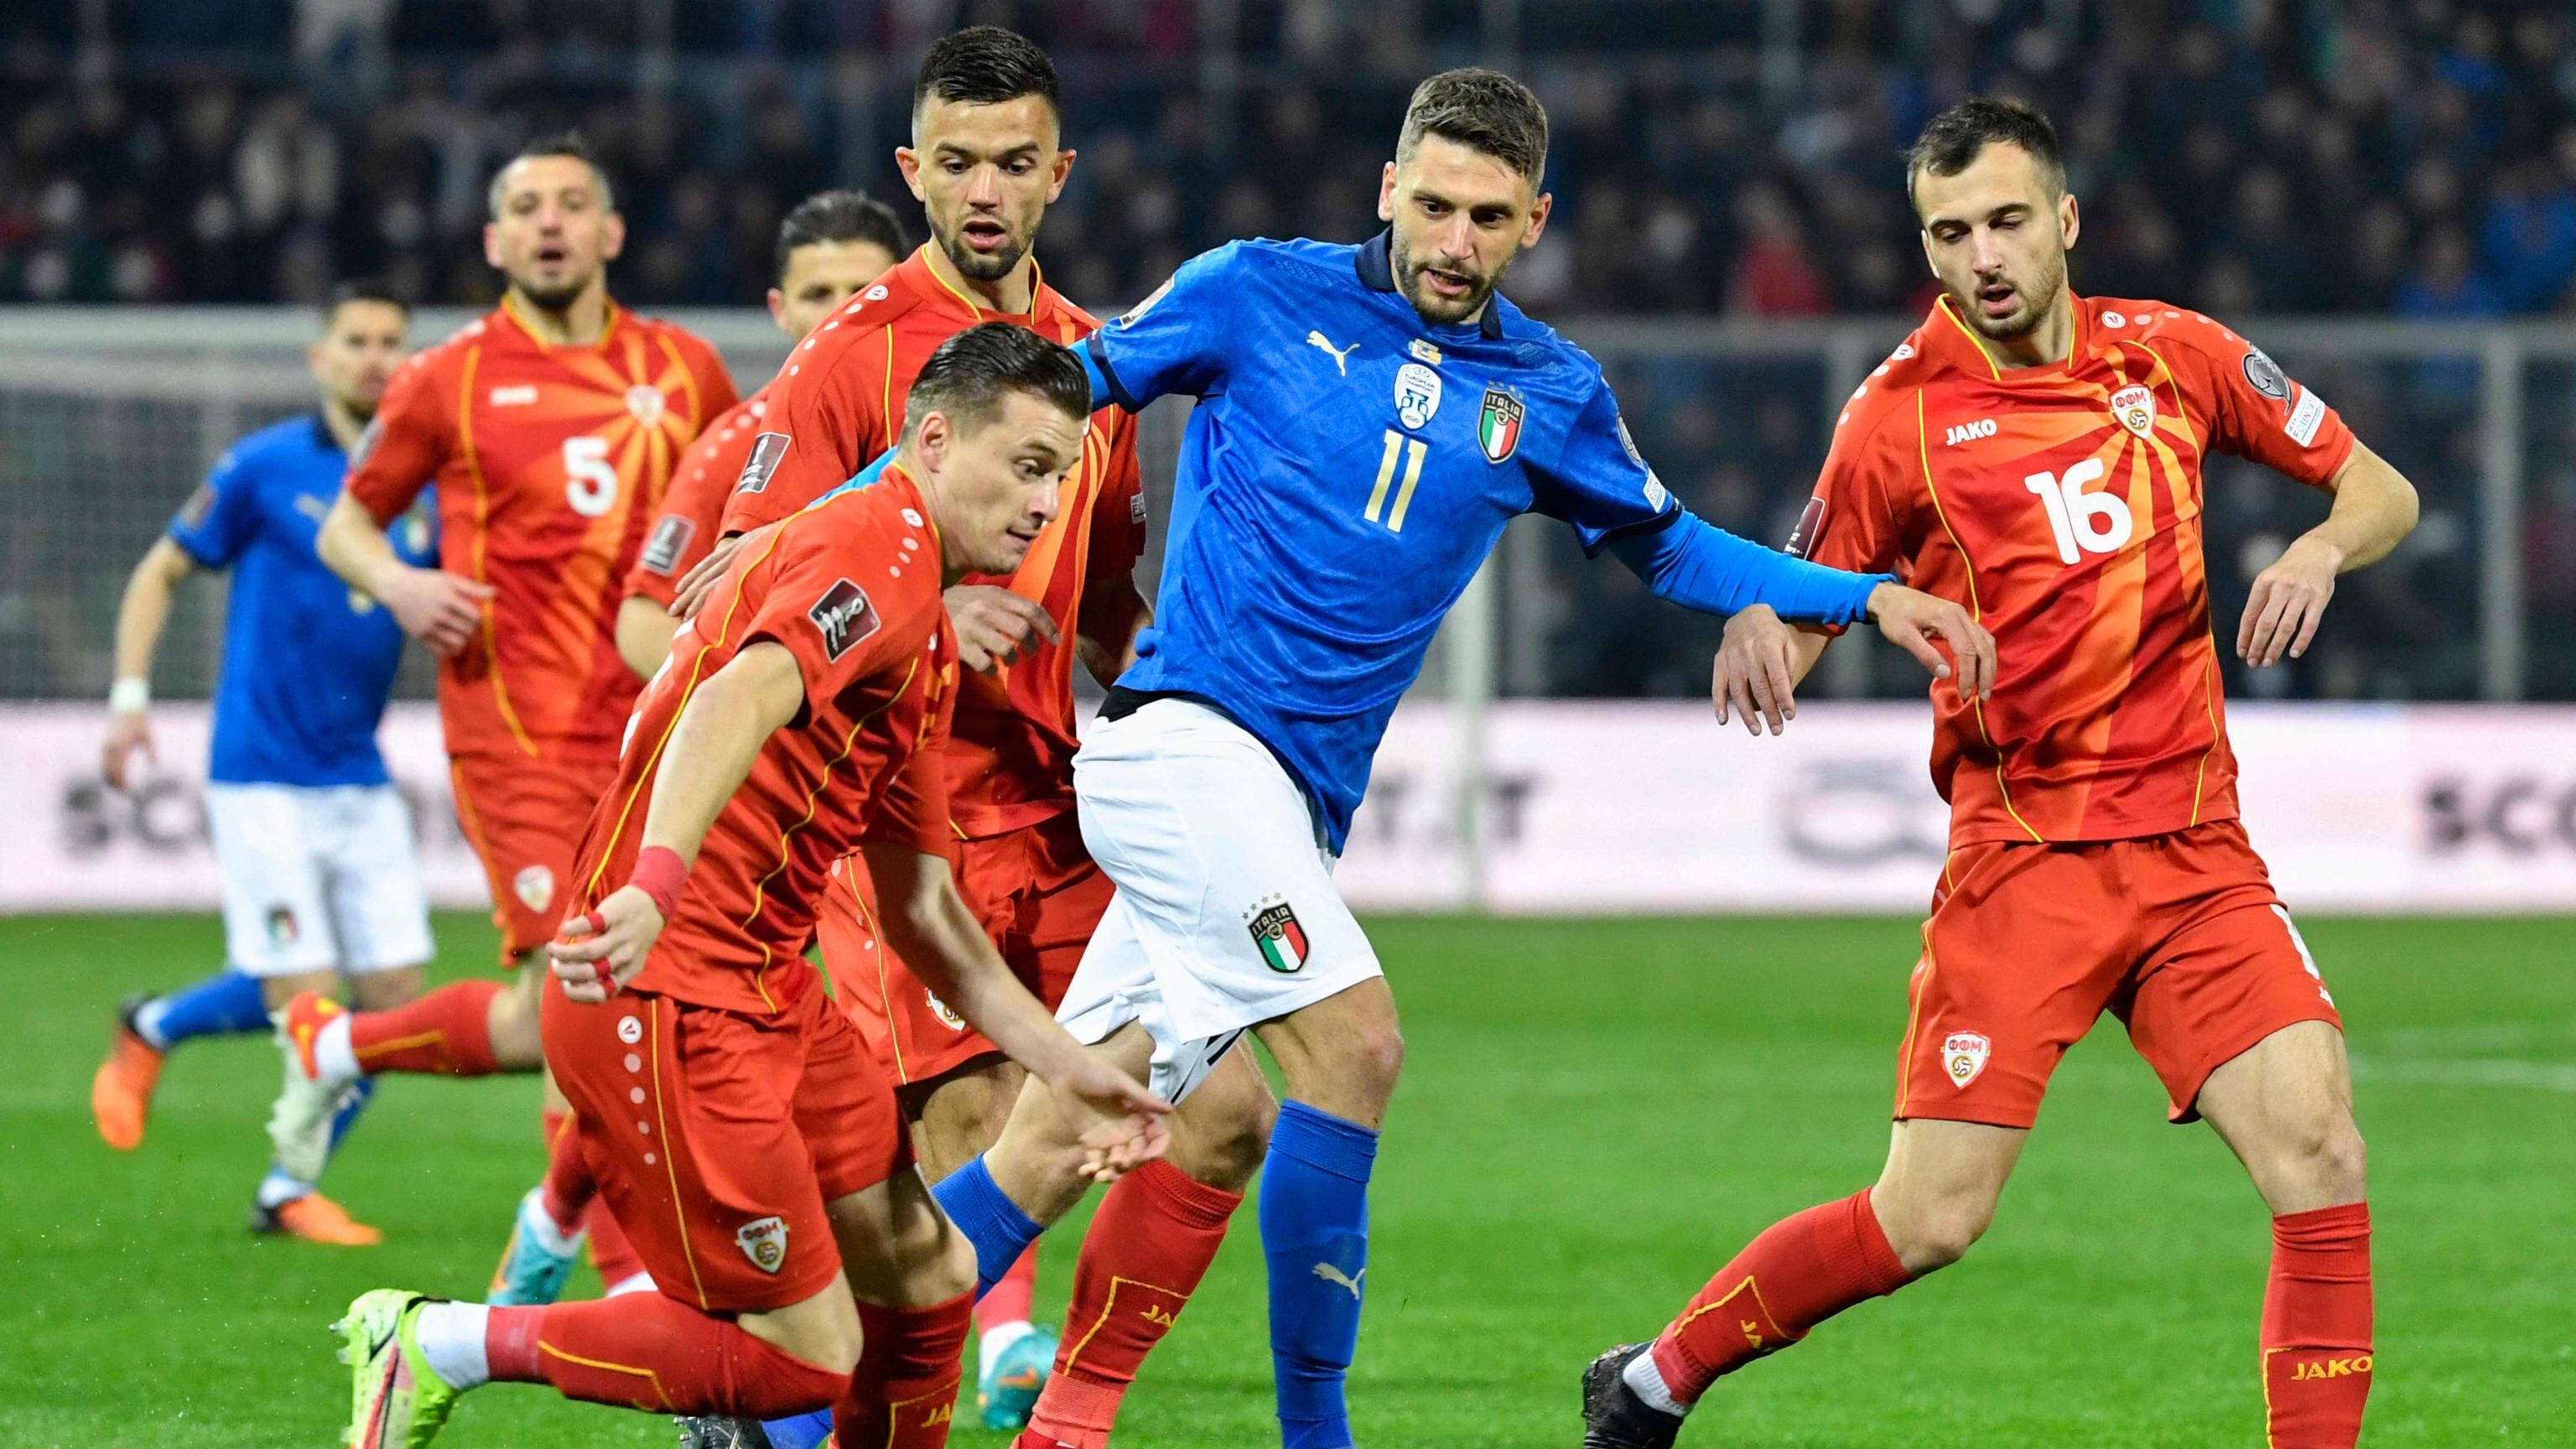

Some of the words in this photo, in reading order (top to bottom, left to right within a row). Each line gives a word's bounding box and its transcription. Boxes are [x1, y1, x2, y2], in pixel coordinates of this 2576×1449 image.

[1486, 394, 1520, 418] ITALIA
[1945, 418, 1997, 446] JAKO
[563, 436, 617, 517] 5
[1363, 428, 1428, 533] 11
[2023, 457, 2133, 564] 16
[1251, 906, 1290, 936] ITALIA
[2291, 1355, 2372, 1381] JAKO
